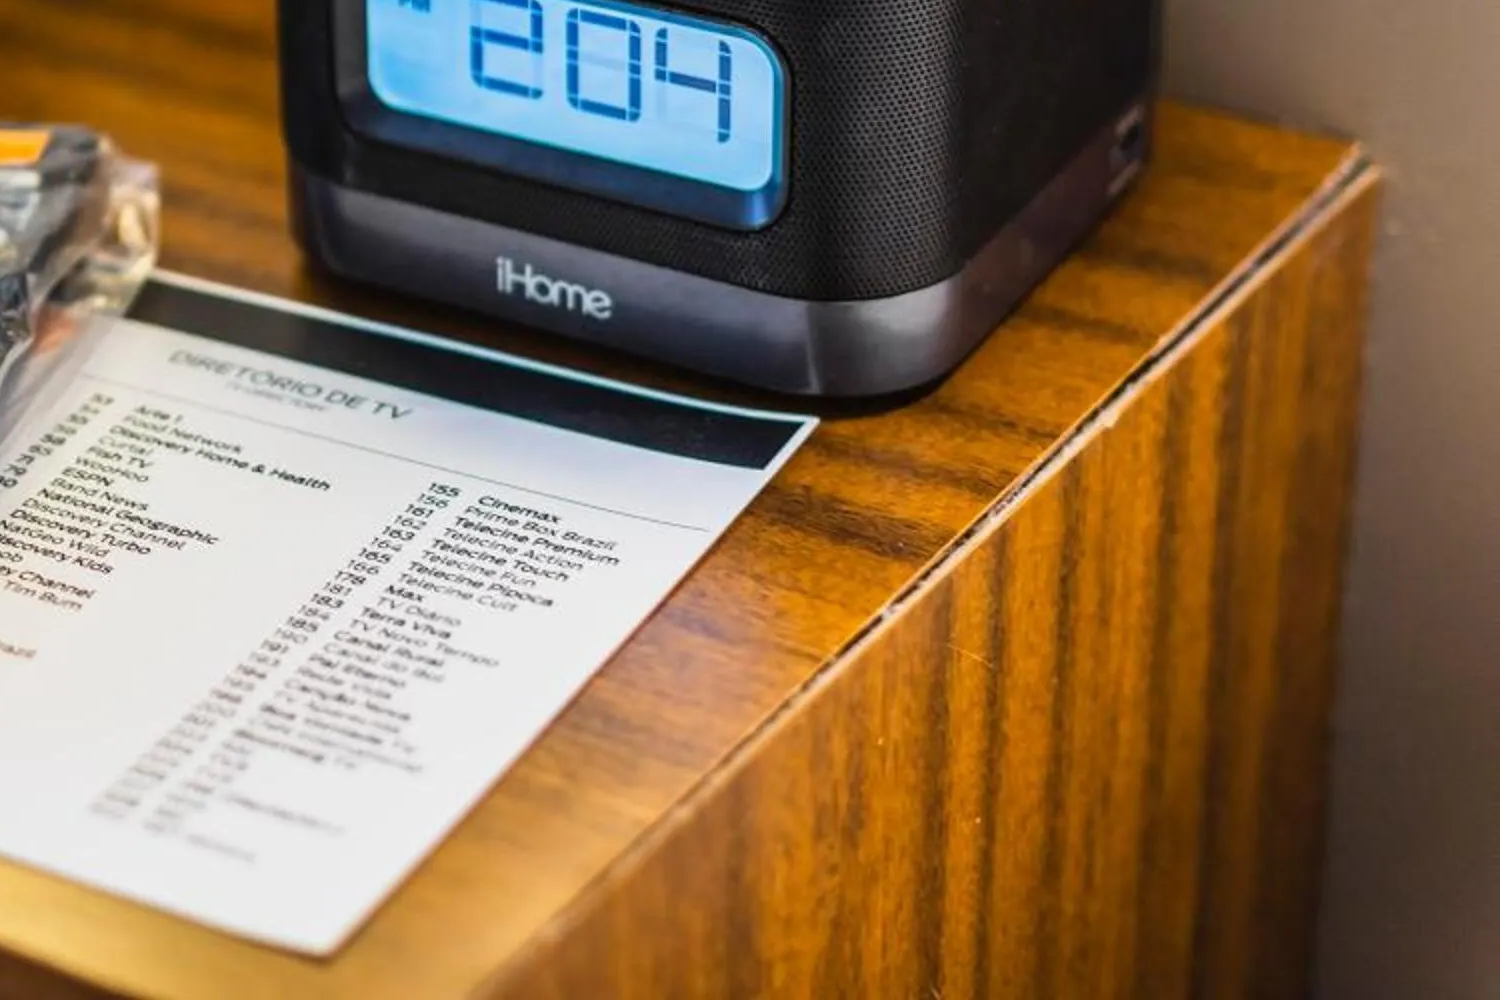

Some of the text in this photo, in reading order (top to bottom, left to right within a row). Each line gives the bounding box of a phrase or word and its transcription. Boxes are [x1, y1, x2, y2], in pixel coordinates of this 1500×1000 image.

[496, 256, 612, 319] iHome
[167, 349, 323, 398] DIRETÓRIO
[325, 389, 362, 410] DE
[372, 400, 415, 420] TV
[170, 426, 242, 453] Network
[62, 466, 115, 487] ESPN
[109, 425, 332, 492] Discovery Home & Health
[128, 456, 154, 469] TV
[51, 477, 99, 498] Band
[100, 491, 150, 512] News
[427, 481, 561, 525] 155 Cinemax
[9, 509, 94, 540] Discovery
[99, 533, 151, 555] Turbo
[21, 498, 107, 529] Discovery
[108, 522, 187, 551] Channel
[36, 487, 113, 516] National
[115, 508, 221, 546] Geographic
[404, 503, 621, 567] 161 Telecine Premium
[415, 493, 618, 552] 156 Prime Box Brazil
[68, 538, 111, 559] Wild
[381, 525, 570, 583] 163 Telecine Touch
[393, 514, 584, 572] 162 Telecine Action
[72, 554, 115, 575] Kids
[358, 547, 554, 608] 165 Telecine Pipoca
[421, 549, 497, 578] Telecine
[499, 571, 537, 588] Fun
[1, 579, 37, 598] Tim
[38, 591, 84, 613] Bum
[18, 569, 98, 601] Channel
[377, 596, 404, 609] TV
[384, 584, 425, 603] Max
[398, 572, 474, 601] Telecine
[349, 618, 375, 632] TV
[360, 606, 406, 627] Terra
[411, 620, 452, 639] Viva
